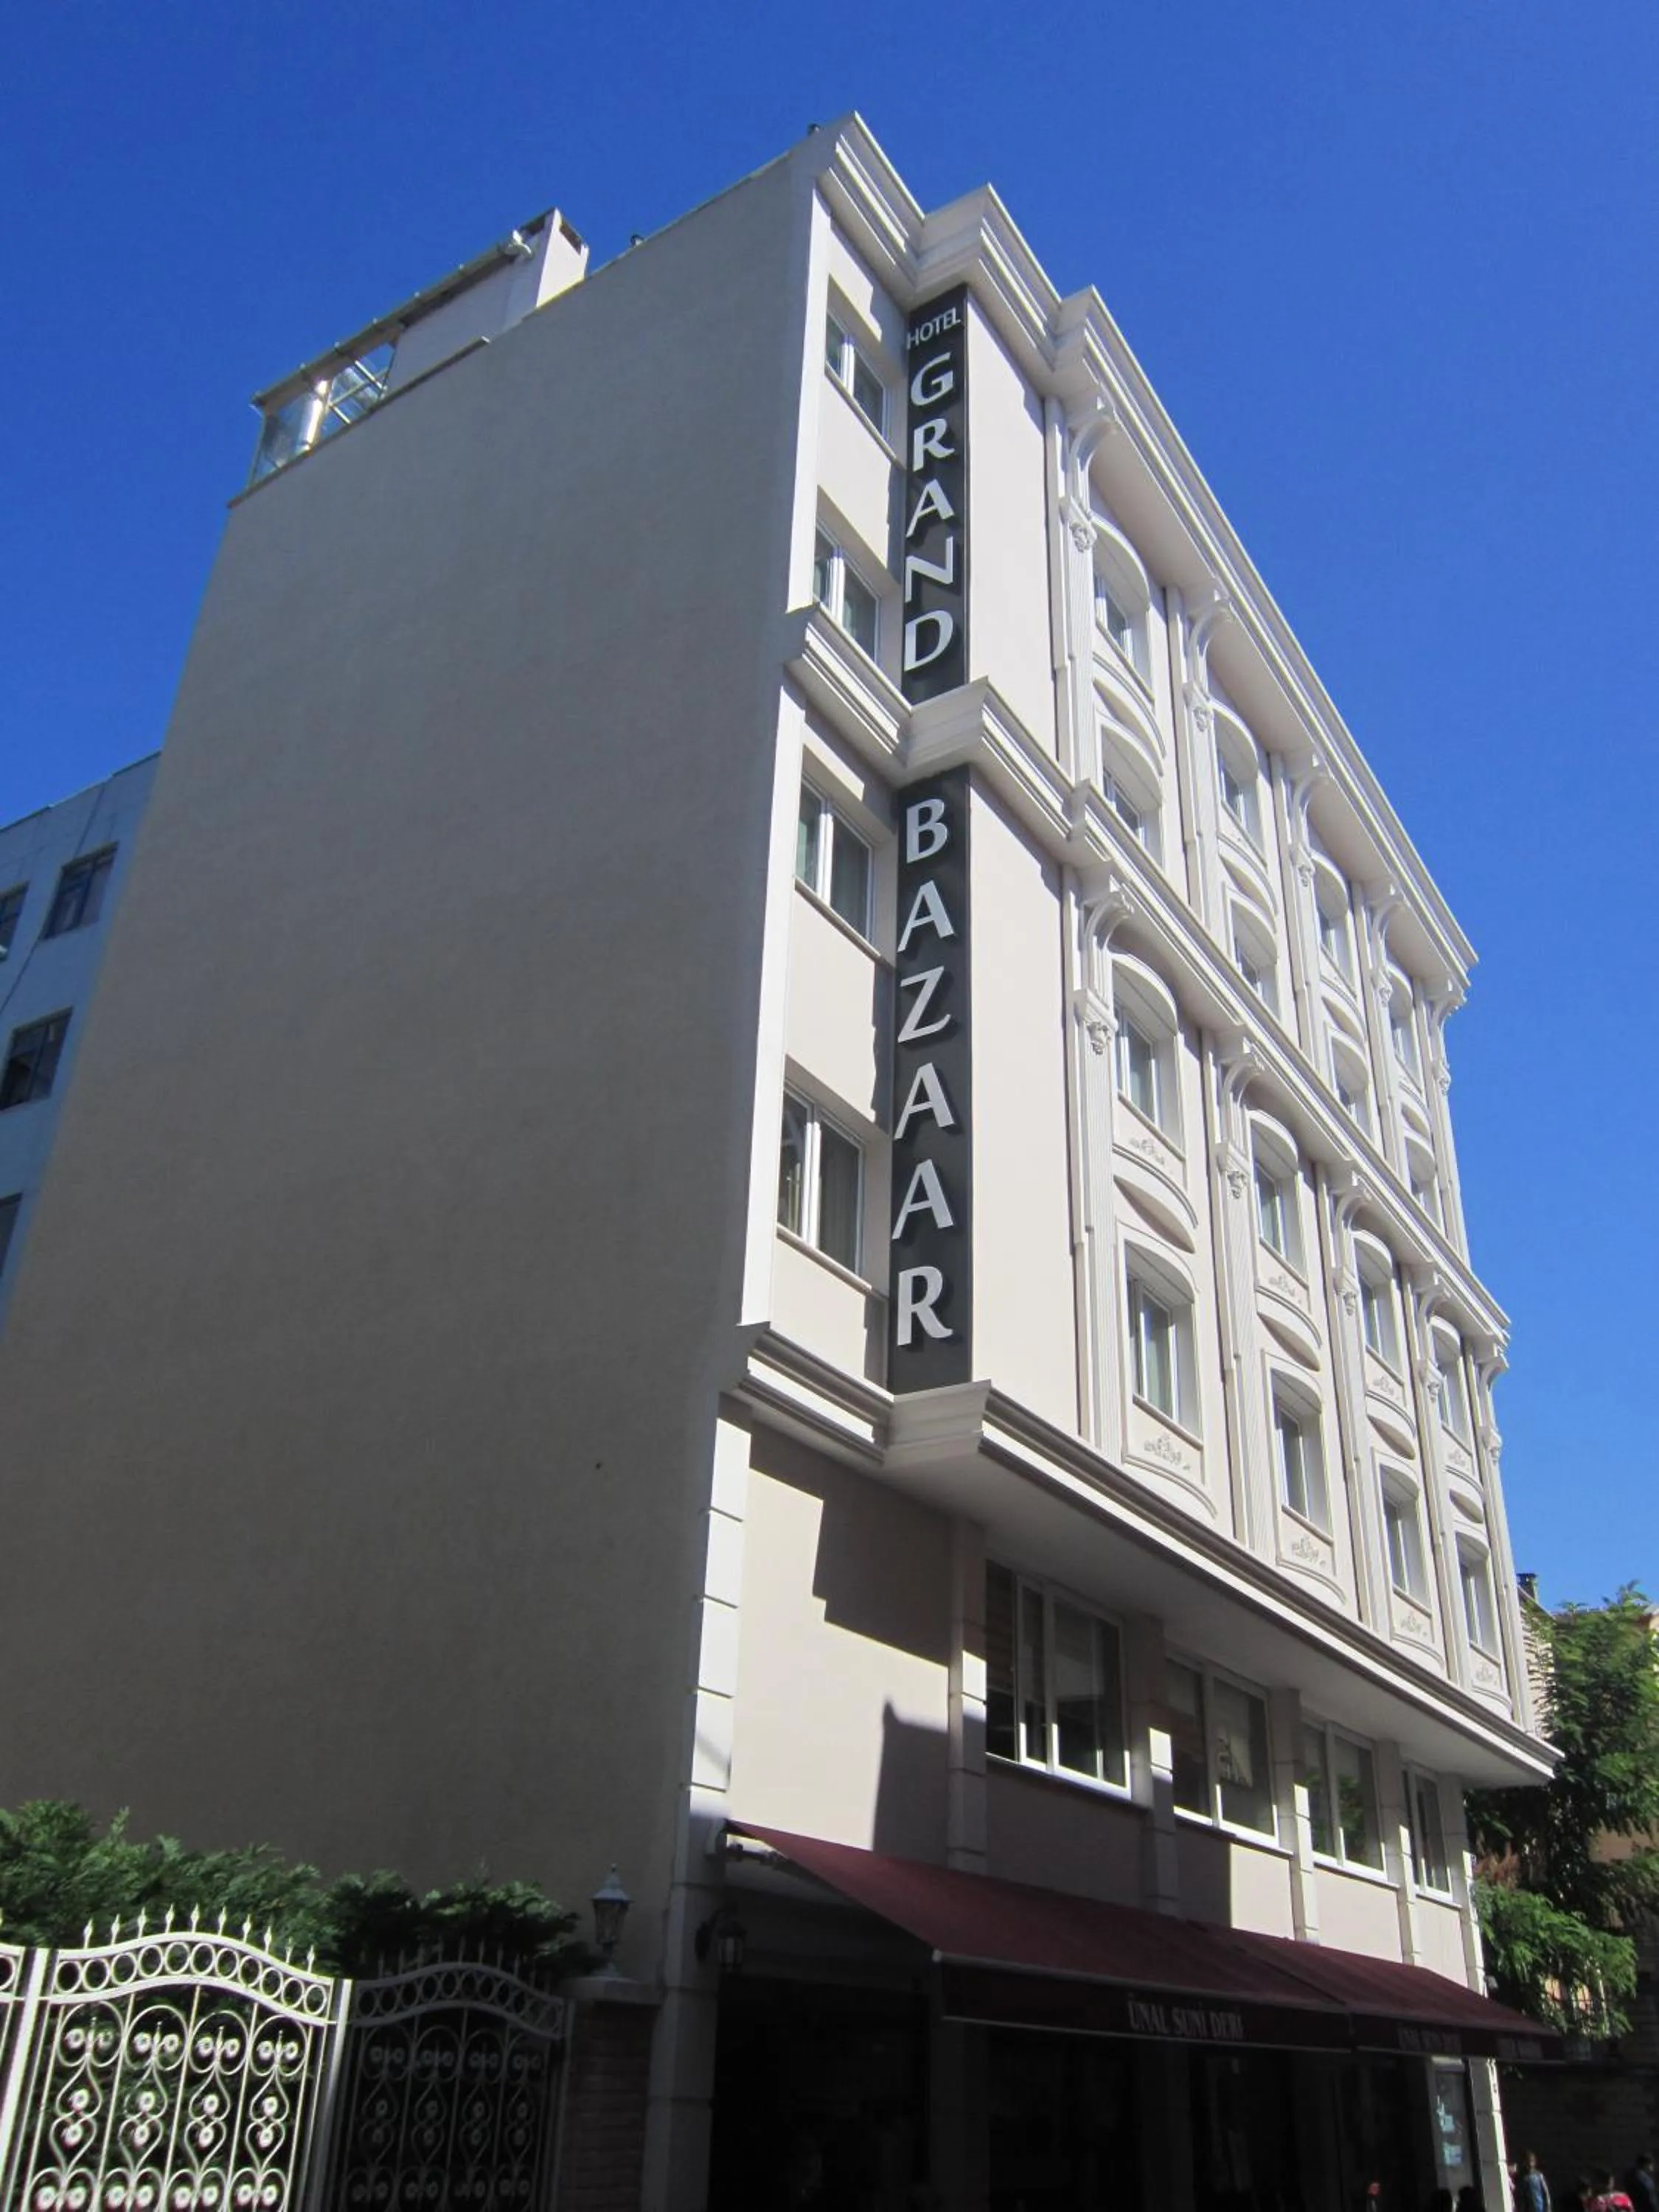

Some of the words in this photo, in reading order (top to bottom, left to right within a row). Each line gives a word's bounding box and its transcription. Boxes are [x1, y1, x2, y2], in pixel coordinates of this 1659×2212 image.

[906, 307, 961, 350] HOTEL
[904, 352, 955, 672] GRAND
[892, 799, 956, 1346] BAZAAR
